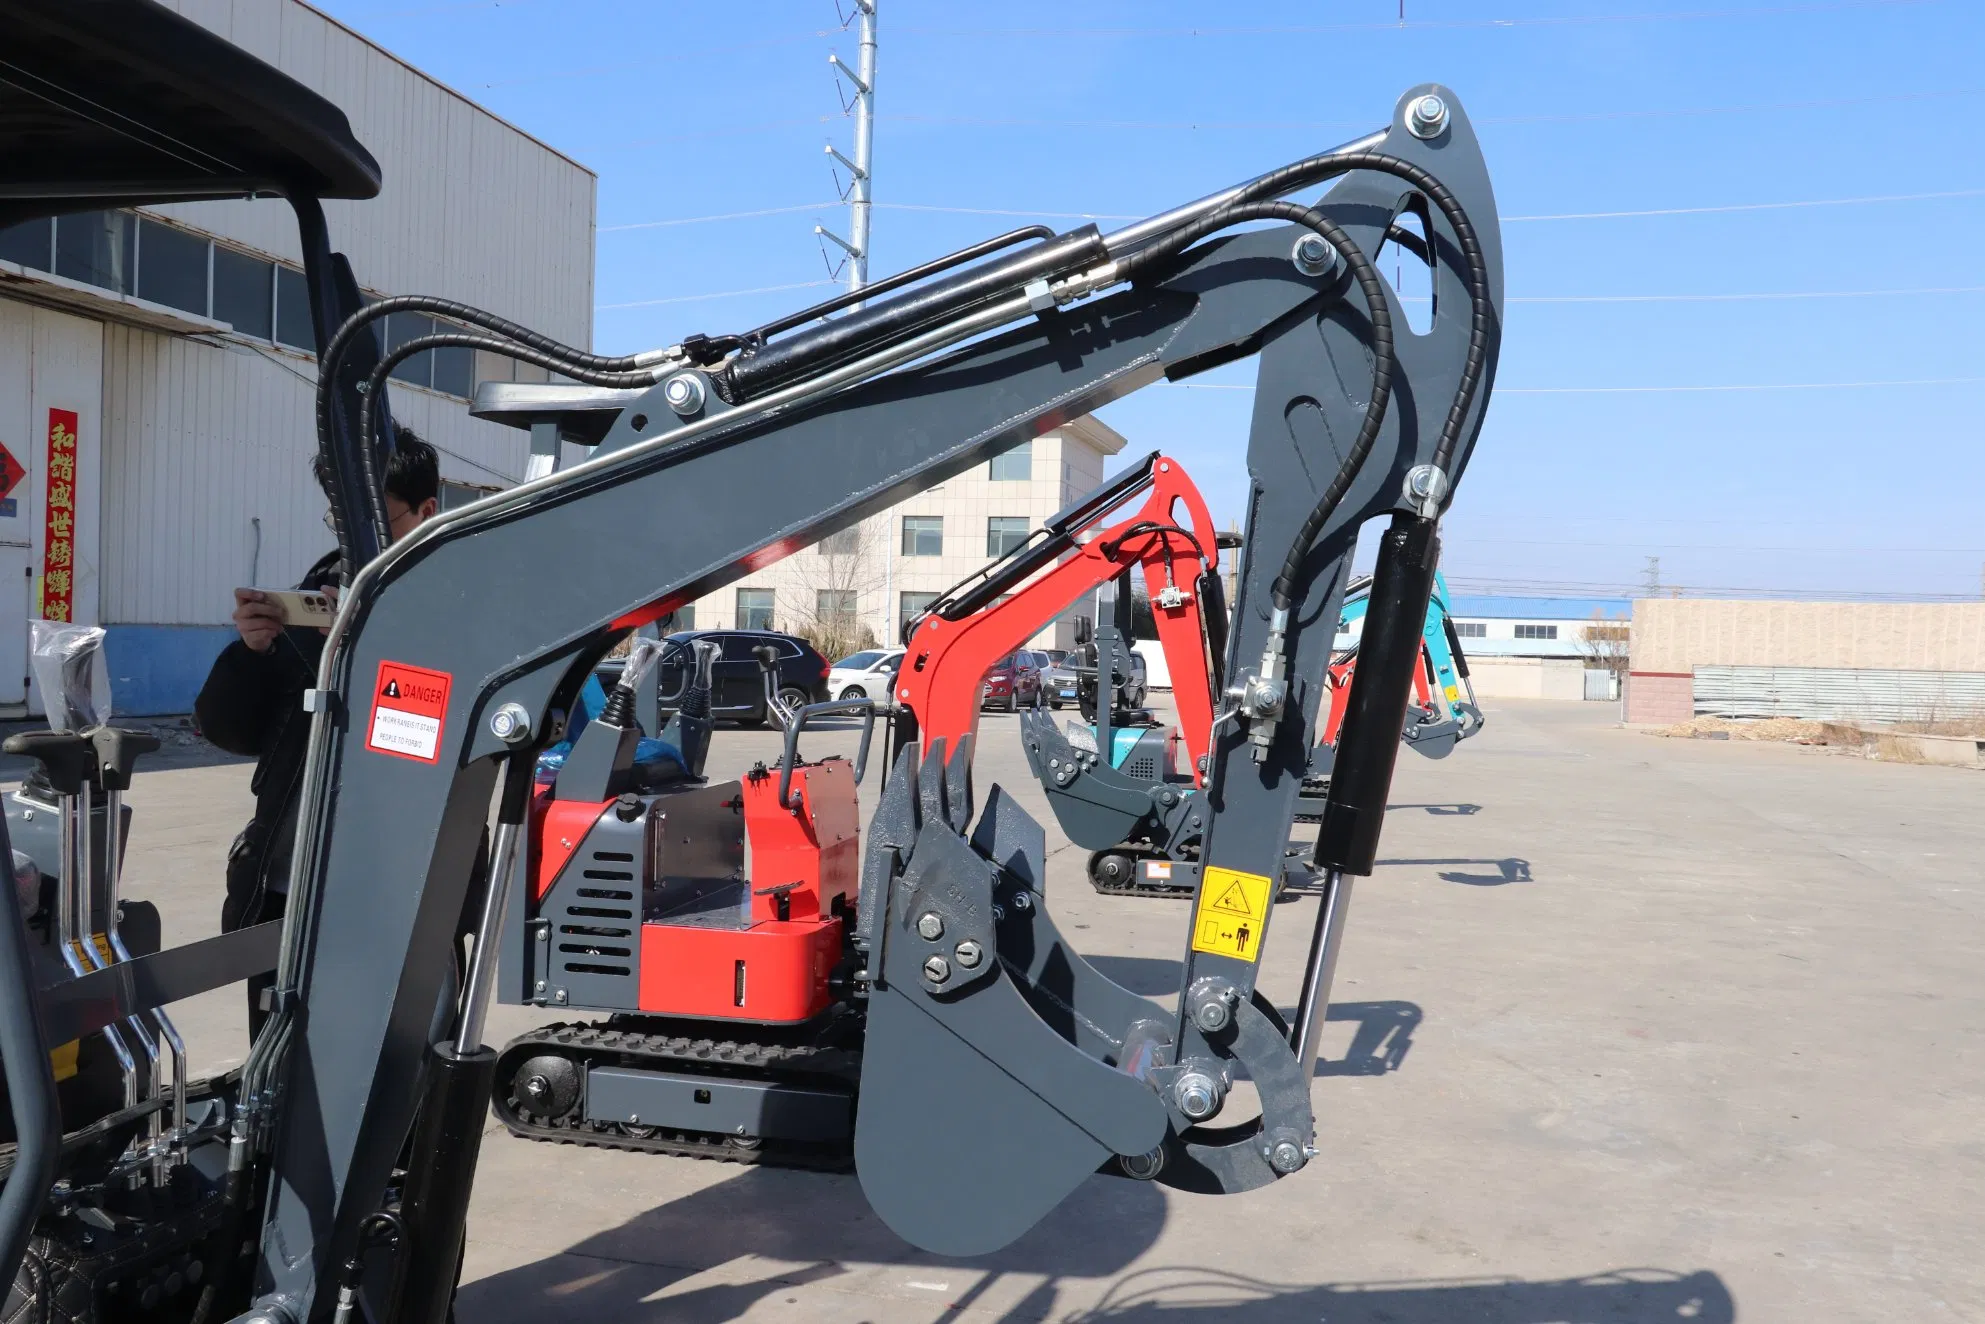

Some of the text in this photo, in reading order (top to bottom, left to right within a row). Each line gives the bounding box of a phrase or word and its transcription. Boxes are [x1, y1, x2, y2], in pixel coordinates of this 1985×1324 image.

[403, 683, 443, 704] DANGER
[420, 723, 437, 734] STAND
[379, 732, 397, 743] PEOPLE
[398, 736, 404, 745] TO
